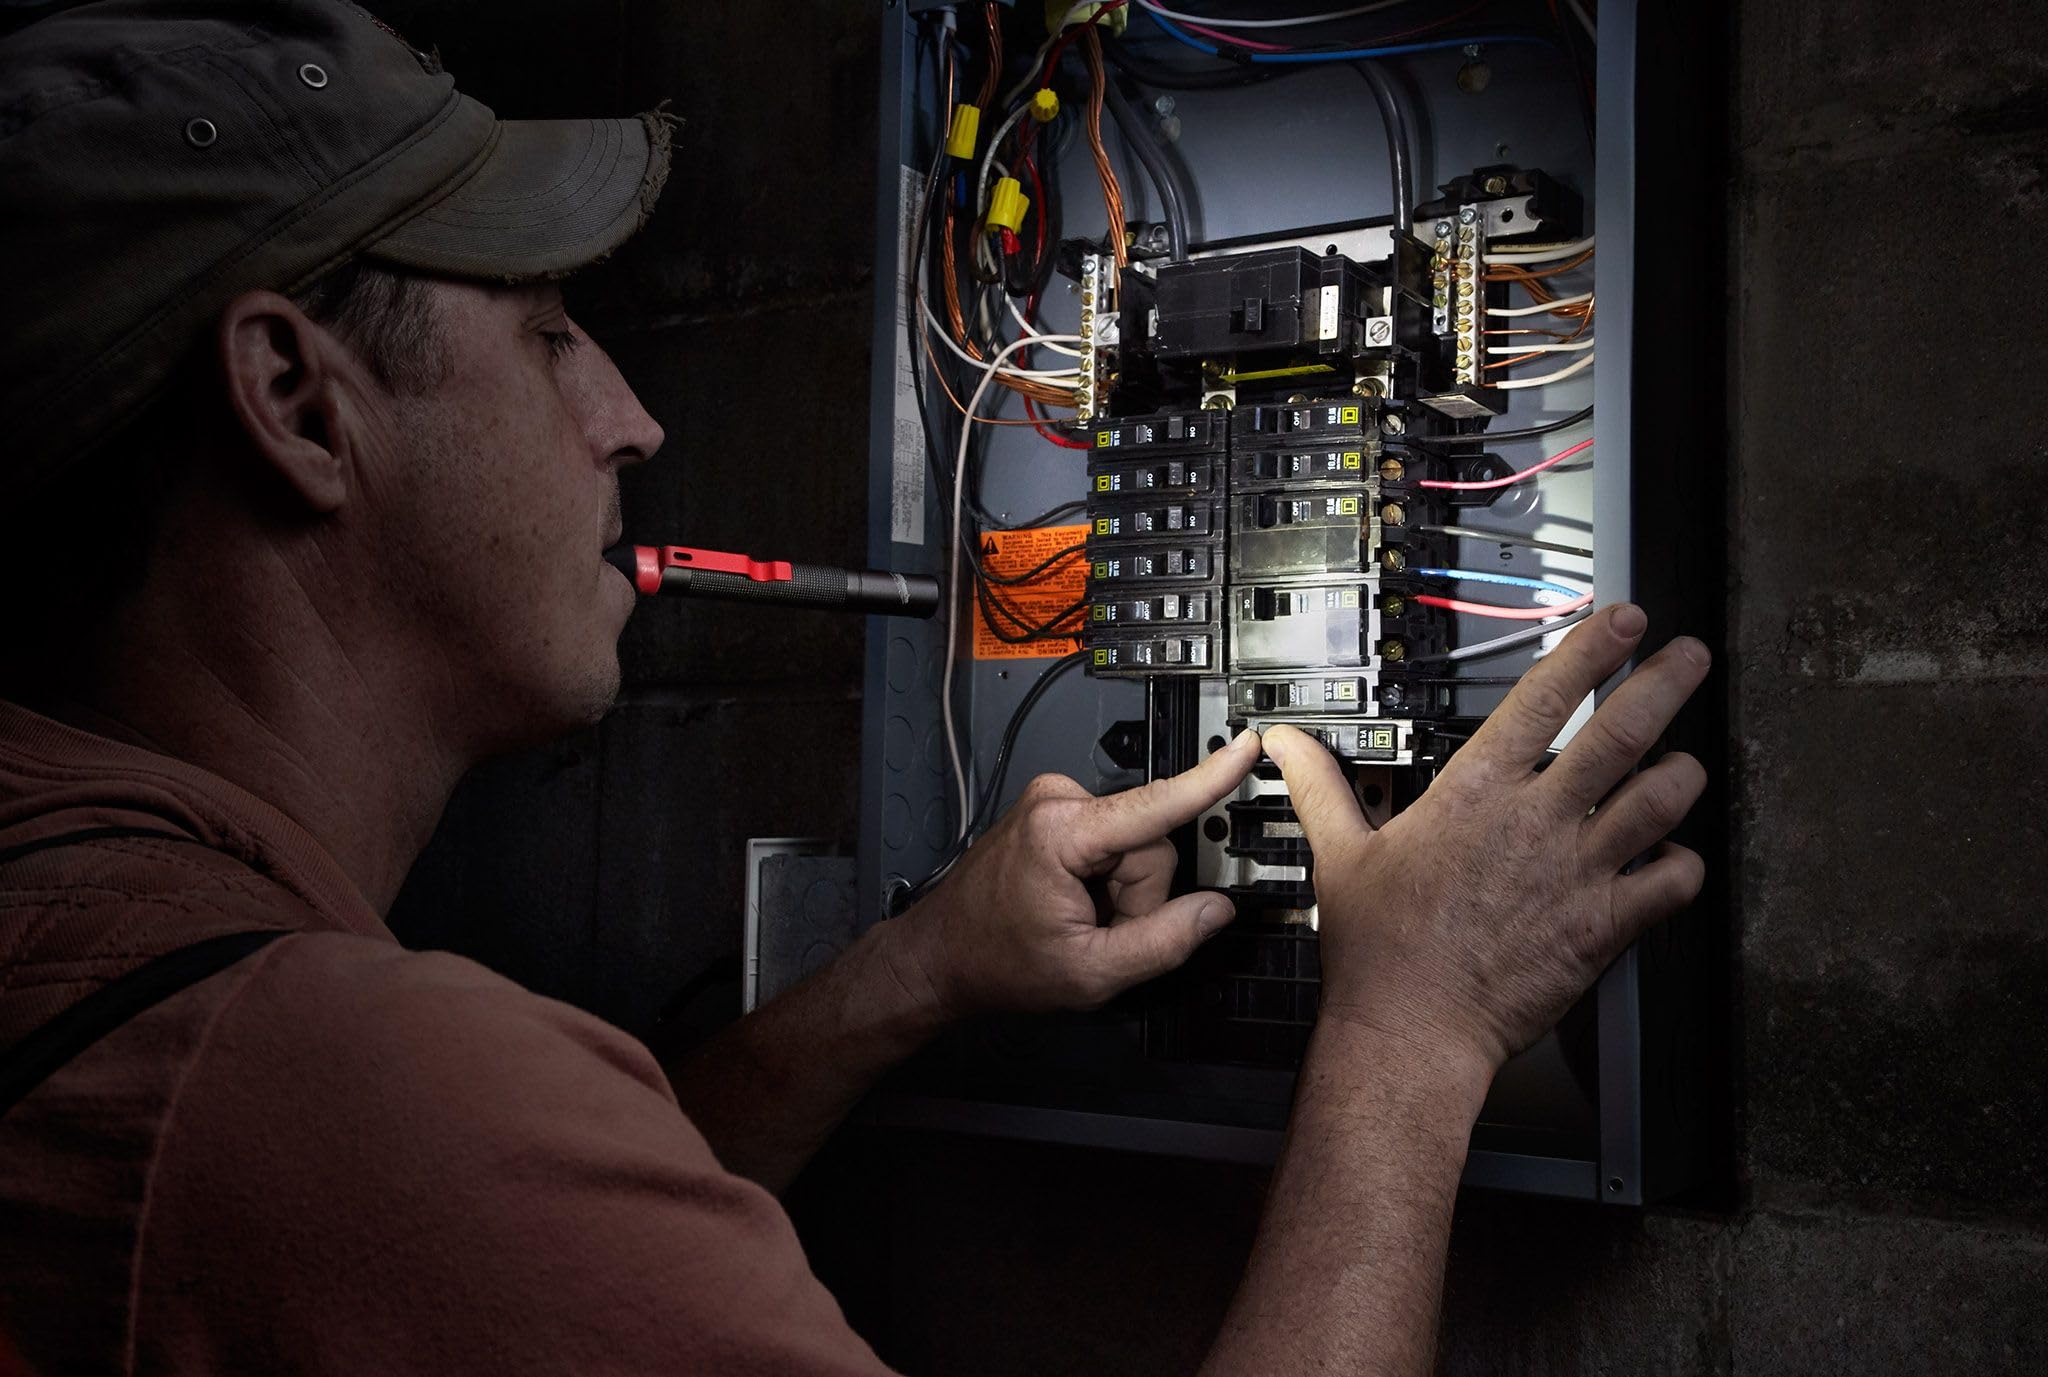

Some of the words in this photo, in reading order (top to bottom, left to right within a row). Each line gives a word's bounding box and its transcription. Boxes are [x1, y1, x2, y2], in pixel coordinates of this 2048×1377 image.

[1189, 426, 1196, 438] ON
[1190, 472, 1197, 483] ON
[1189, 515, 1196, 527] ON
[1189, 558, 1196, 570] ON
[1167, 601, 1175, 611] 15
[1325, 682, 1332, 691] kA
[1247, 689, 1253, 699] 20
[1325, 692, 1332, 700] 10
[1360, 730, 1367, 739] kA
[1360, 739, 1367, 748] 10
